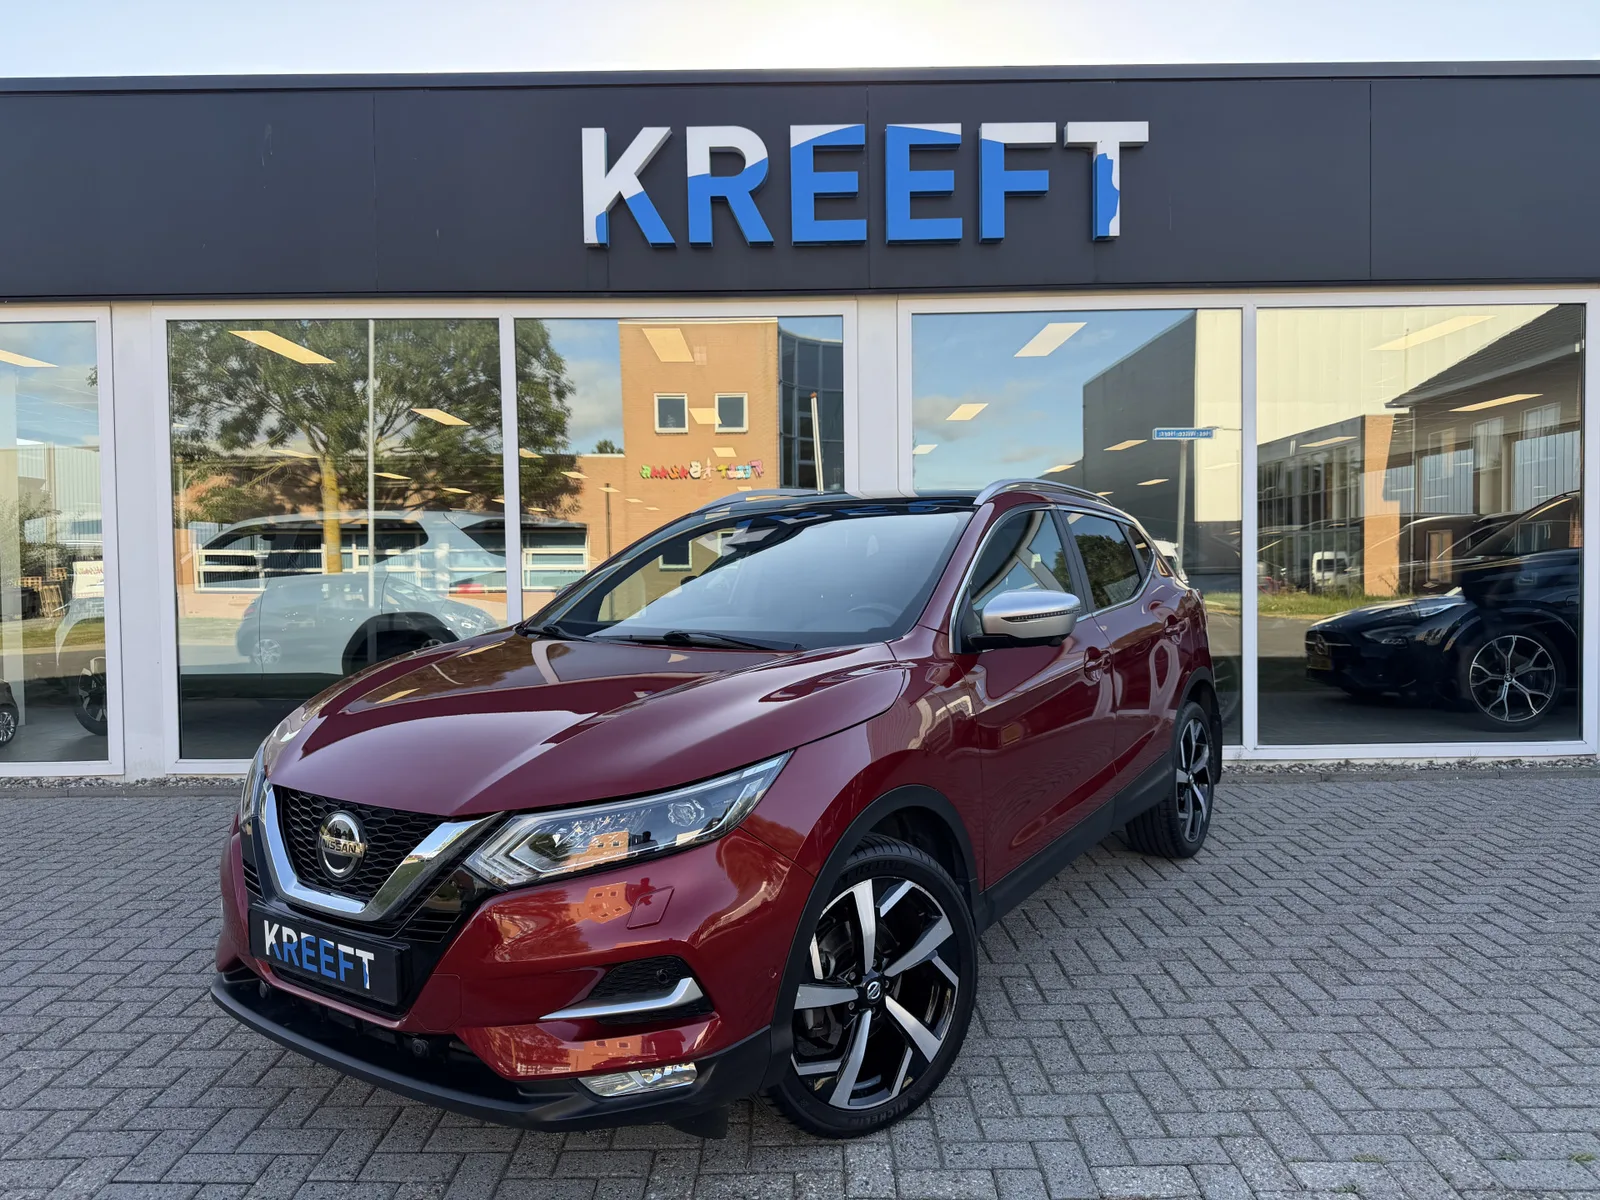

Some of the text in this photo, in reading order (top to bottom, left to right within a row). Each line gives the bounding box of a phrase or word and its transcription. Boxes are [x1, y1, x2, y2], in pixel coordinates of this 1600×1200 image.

[582, 121, 1149, 247] KREEFT
[322, 838, 357, 854] NISSAN
[263, 919, 375, 990] KREEFT
